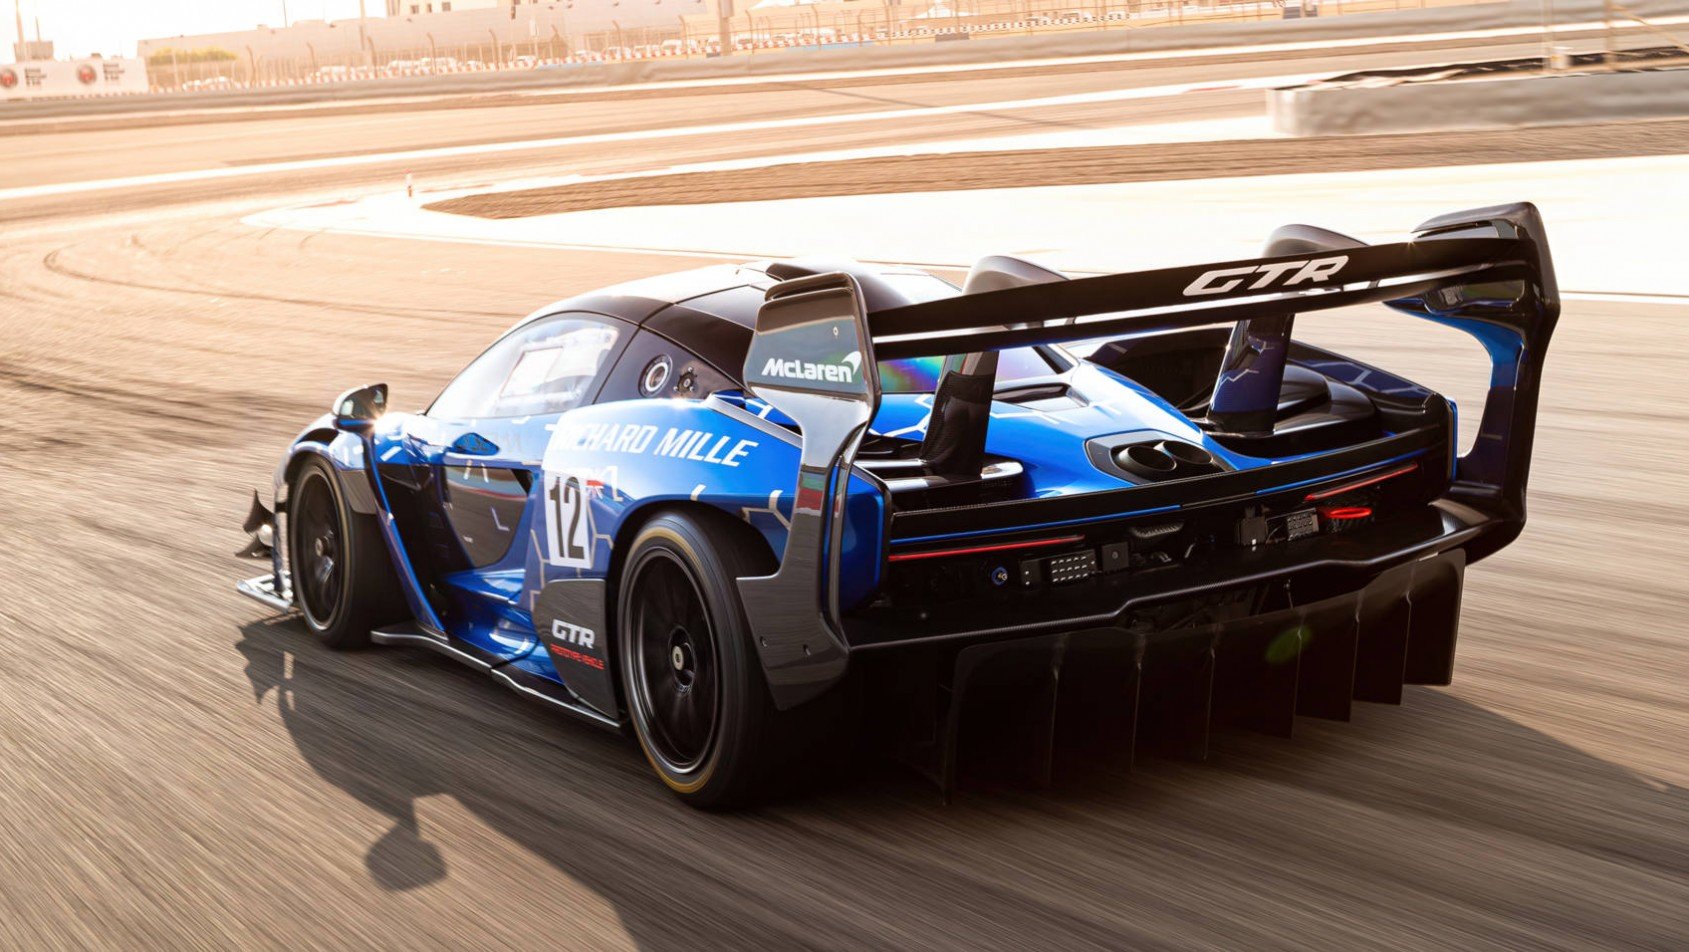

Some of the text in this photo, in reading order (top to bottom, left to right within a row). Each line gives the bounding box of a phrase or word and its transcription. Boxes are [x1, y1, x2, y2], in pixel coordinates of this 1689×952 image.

[1182, 255, 1350, 297] GTR
[761, 357, 853, 383] McLaren
[553, 423, 759, 467] ICHARD MILLE
[549, 476, 585, 559] 12
[552, 618, 595, 649] GTR
